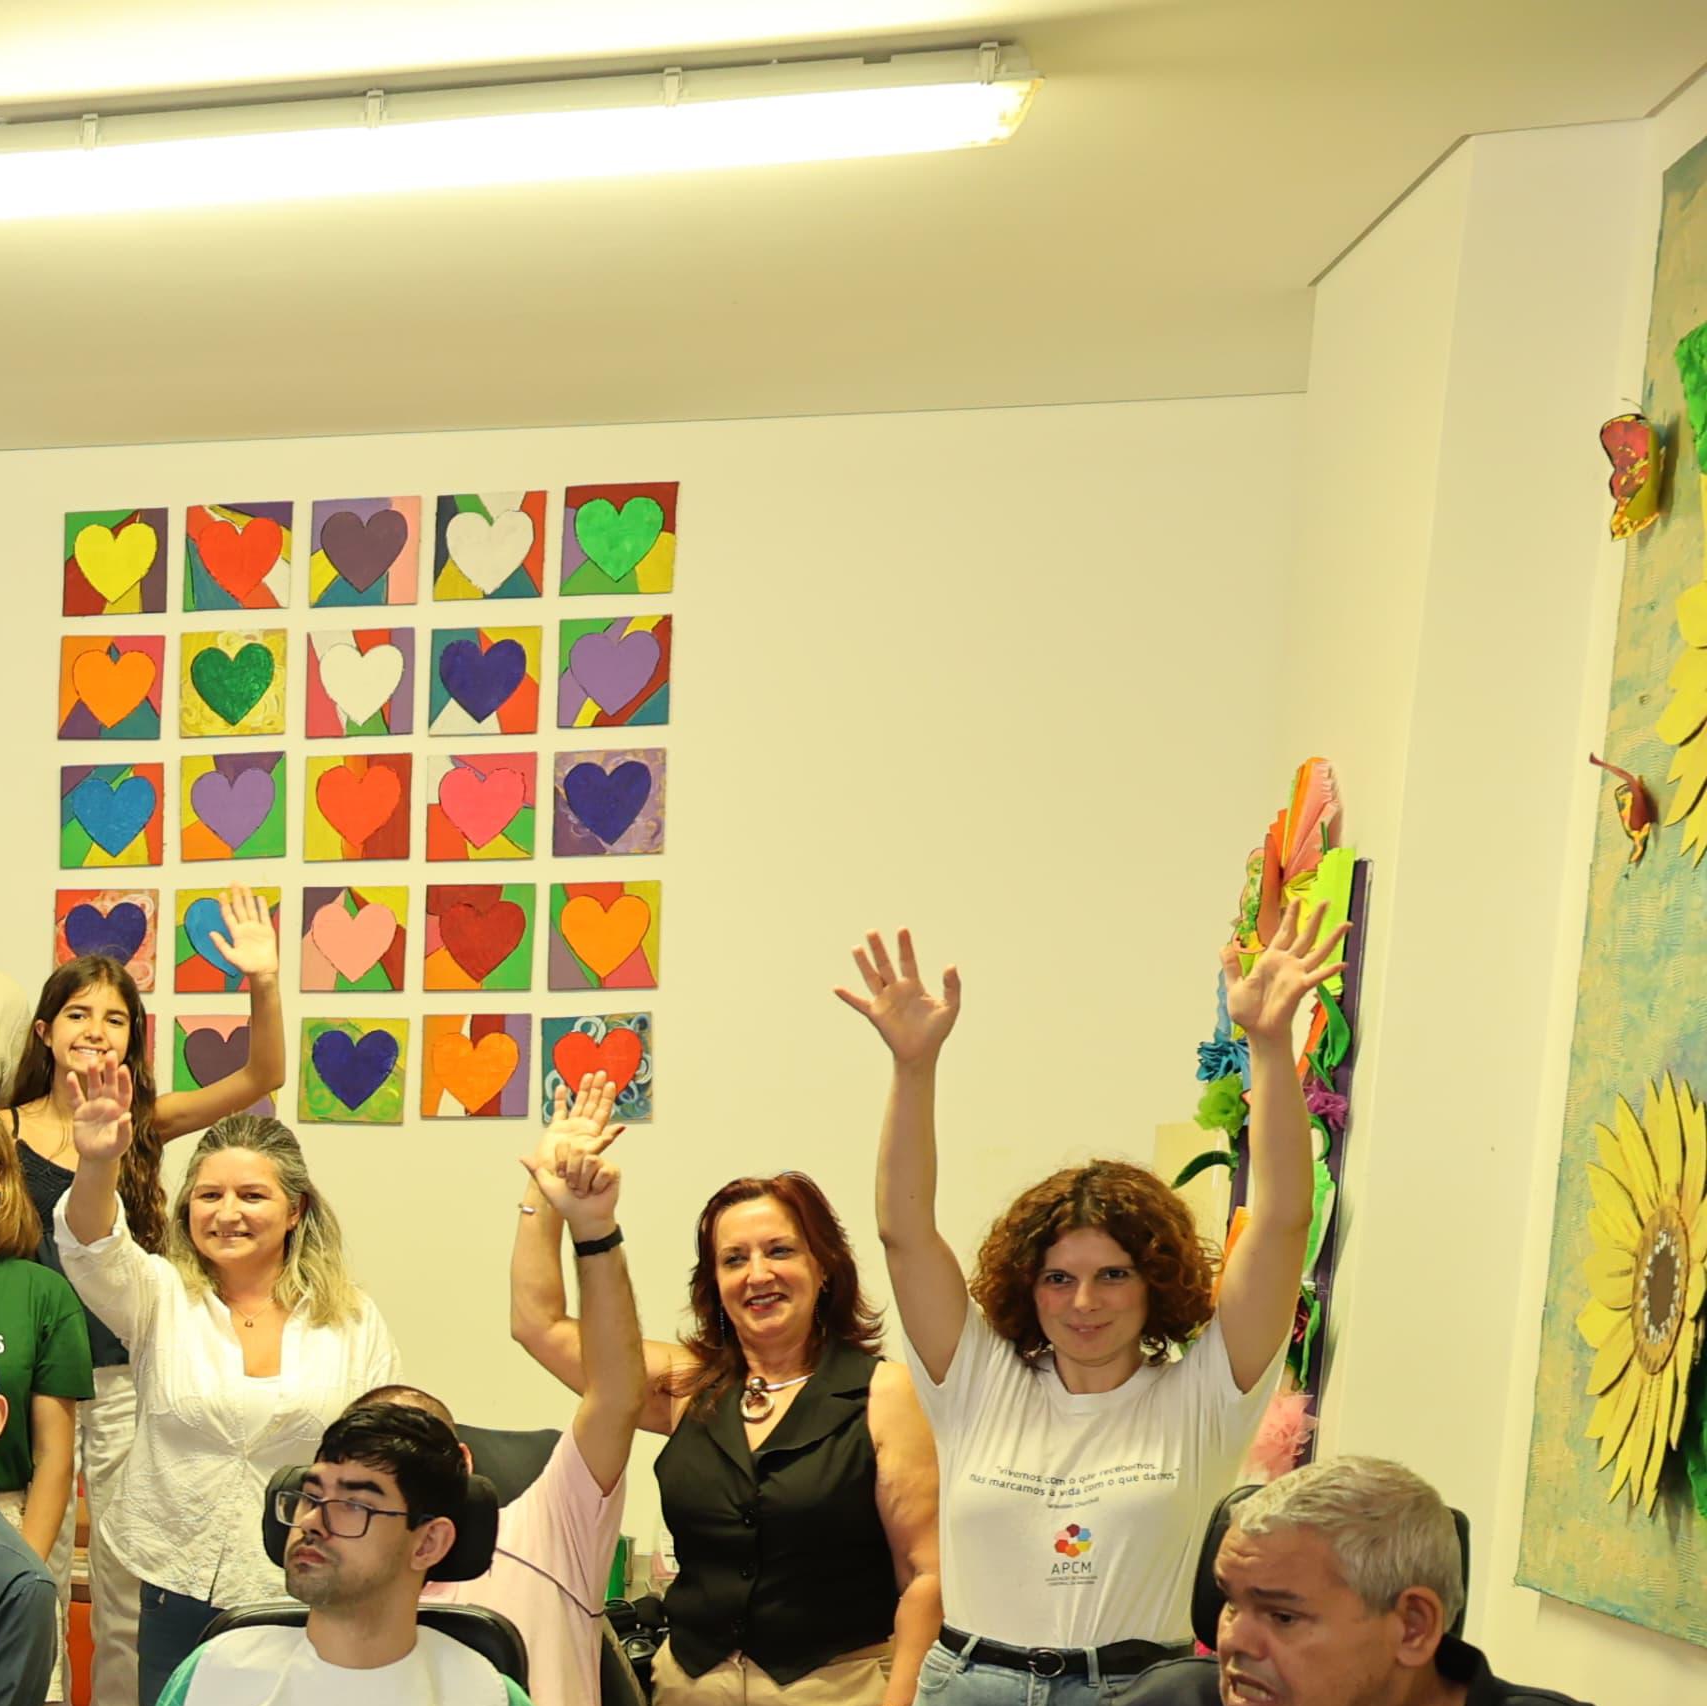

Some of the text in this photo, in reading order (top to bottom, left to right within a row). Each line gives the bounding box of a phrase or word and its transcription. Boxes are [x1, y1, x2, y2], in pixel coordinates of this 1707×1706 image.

[989, 1478, 1045, 1496] marcamos
[1118, 1474, 1139, 1485] que
[1051, 1561, 1092, 1576] APCM
